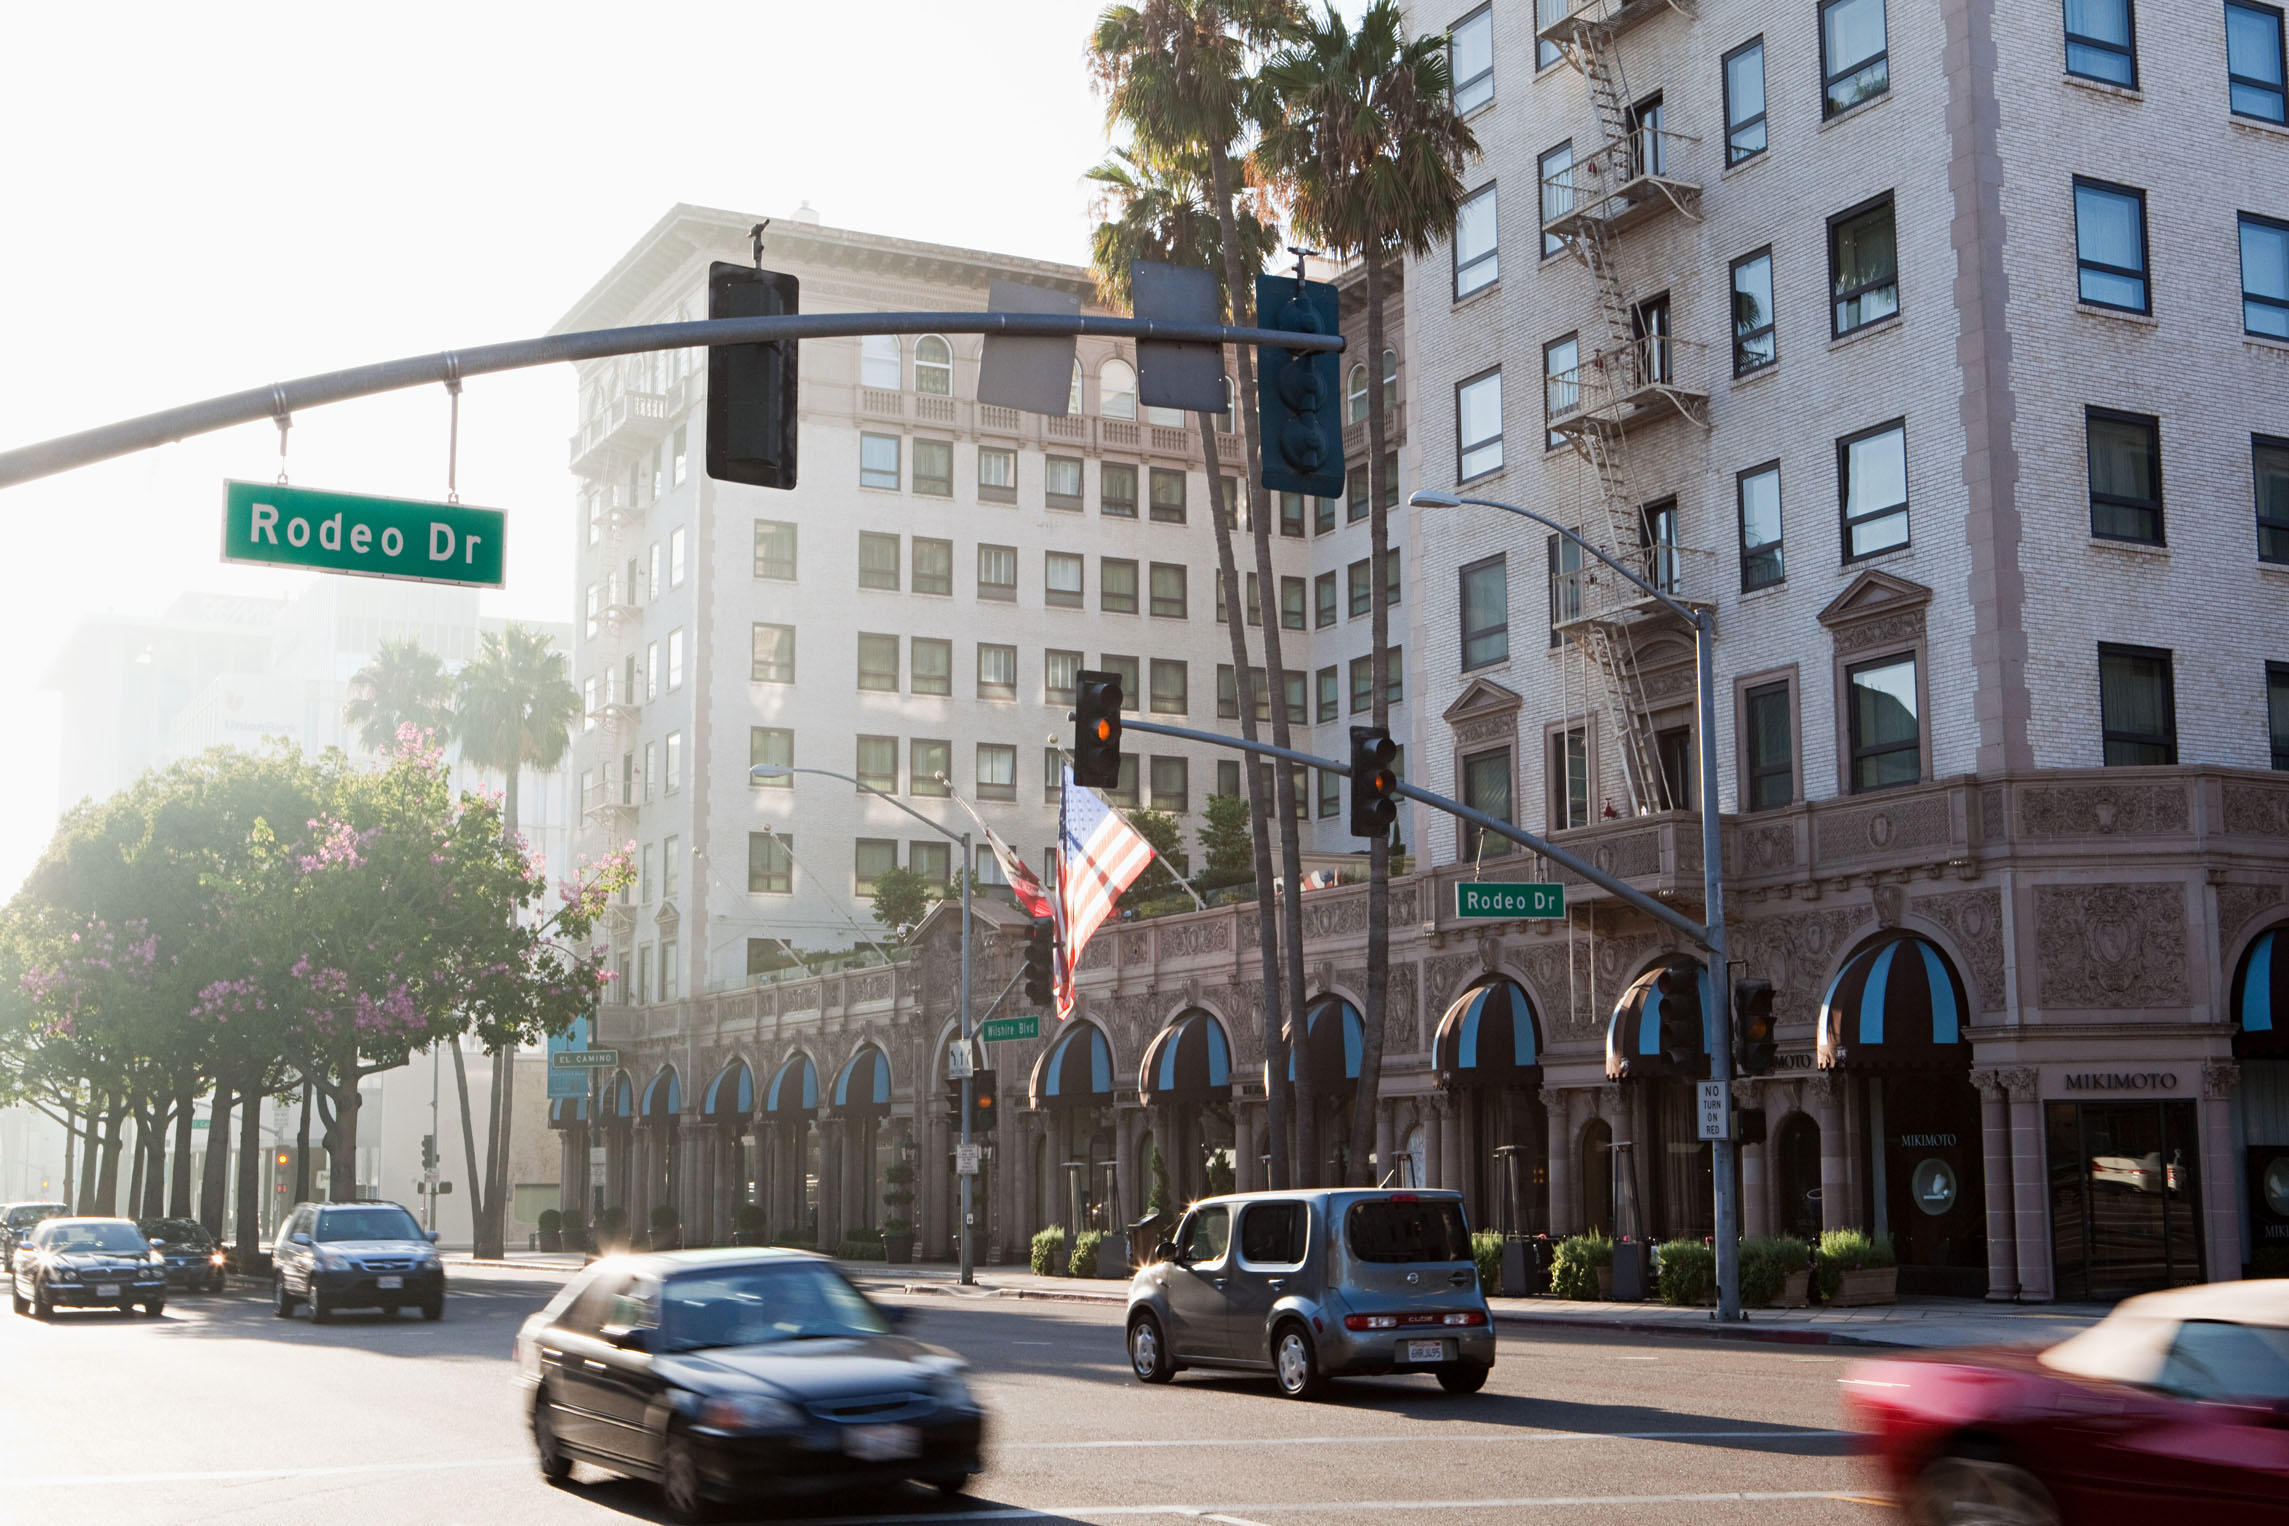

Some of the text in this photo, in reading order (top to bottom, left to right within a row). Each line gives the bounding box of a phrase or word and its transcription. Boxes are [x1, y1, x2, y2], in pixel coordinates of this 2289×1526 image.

[250, 503, 482, 564] Rodeo Dr
[1467, 891, 1555, 909] Rodeo Dr
[987, 1022, 1034, 1037] Wilshire Blvd
[559, 1055, 612, 1064] EL CAMINO
[1775, 1054, 1812, 1070] MOTO
[2065, 1072, 2177, 1090] MIKIMOTO
[1705, 1086, 1719, 1097] NO
[1703, 1100, 1721, 1110] TURN
[1707, 1112, 1718, 1122] ON
[1706, 1125, 1720, 1135] RED
[1901, 1134, 1958, 1147] MIKIMOTO
[2264, 1223, 2289, 1238] MIKI
[1408, 1314, 1433, 1323] cube
